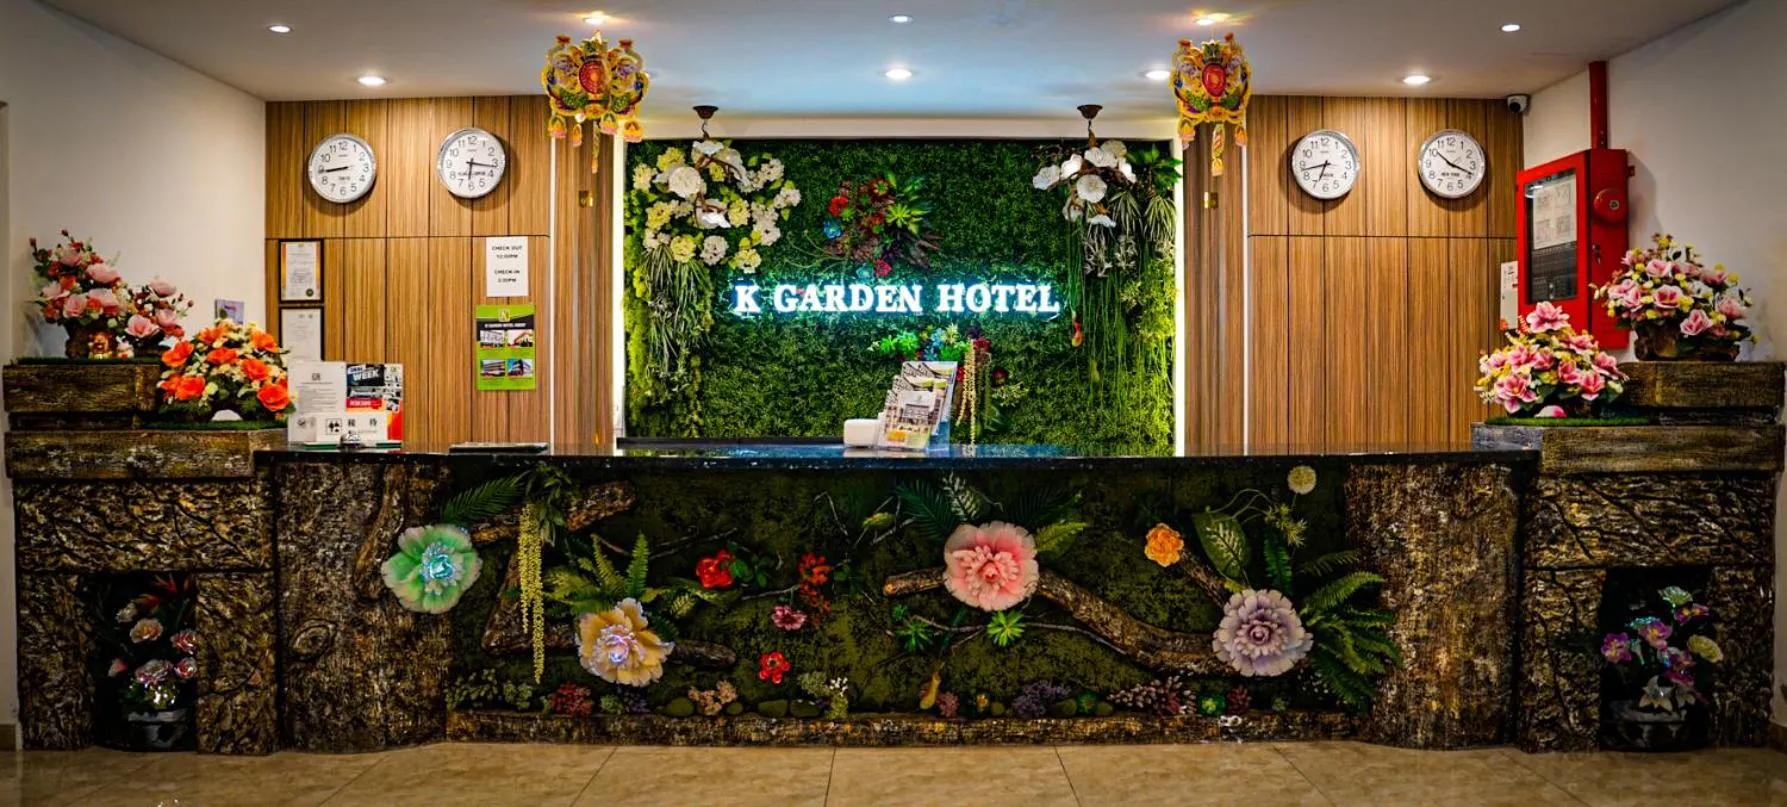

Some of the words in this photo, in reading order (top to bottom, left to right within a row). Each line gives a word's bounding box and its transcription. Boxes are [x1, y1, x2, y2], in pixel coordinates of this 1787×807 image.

[468, 136, 477, 144] 12
[1321, 138, 1329, 146] 12
[1437, 140, 1444, 148] 11
[1447, 138, 1456, 146] 12
[330, 144, 336, 153] 11
[339, 141, 348, 150] 12
[353, 144, 356, 152] 1
[1311, 141, 1318, 149] 11
[1461, 141, 1463, 149] 1
[450, 148, 459, 157] 10
[488, 147, 495, 156] 2
[1303, 149, 1312, 158] 10
[1341, 150, 1347, 158] 2
[1429, 149, 1437, 157] 10
[1466, 150, 1472, 158] 2
[320, 154, 330, 162] 10
[359, 152, 365, 161] 2
[447, 159, 452, 168] 9
[492, 158, 498, 167] 3
[1345, 161, 1351, 169] 3
[1426, 160, 1431, 168] 9
[1470, 161, 1476, 170] 3
[363, 163, 369, 172] 3
[449, 171, 456, 180] 8
[1304, 171, 1310, 180] 8
[1429, 170, 1435, 179] 8
[321, 176, 328, 185] 8
[458, 179, 464, 187] 7
[479, 179, 485, 187] 5
[1312, 180, 1318, 188] 7
[1333, 180, 1339, 189] 5
[1438, 179, 1443, 187] 7
[1458, 180, 1463, 188] 5
[330, 183, 336, 192] 7
[351, 183, 357, 192] 5
[468, 181, 475, 190] 6
[1322, 183, 1329, 192] 6
[1447, 182, 1453, 191] 6
[340, 186, 346, 195] 6
[735, 285, 761, 312] K
[773, 284, 923, 312] GARDEN
[937, 284, 1059, 312] HOTEL
[352, 370, 379, 380] WEEK
